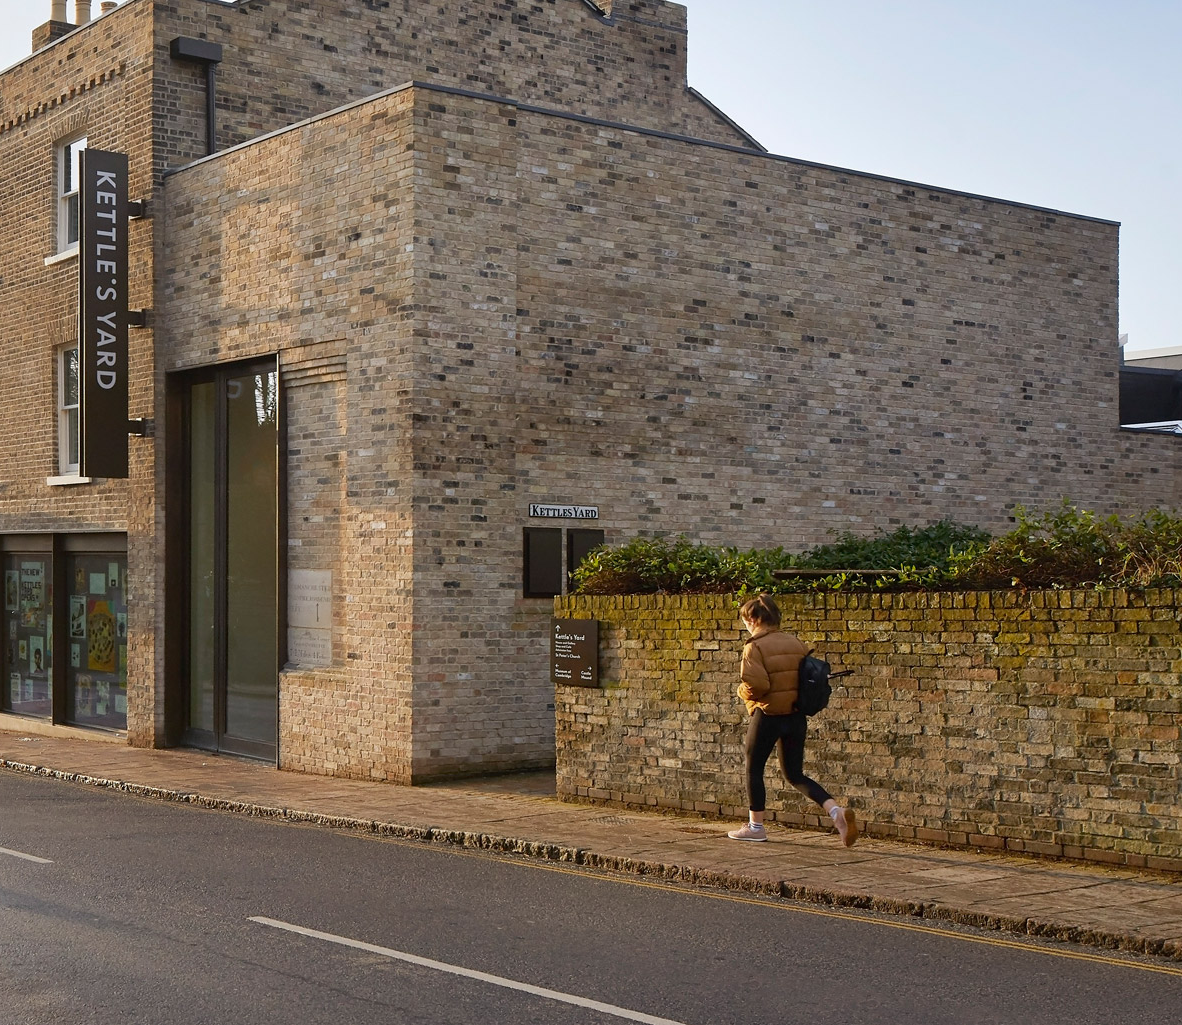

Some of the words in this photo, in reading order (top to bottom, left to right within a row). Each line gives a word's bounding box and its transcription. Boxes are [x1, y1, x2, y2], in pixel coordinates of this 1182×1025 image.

[96, 170, 117, 301] KETTLE'S
[96, 311, 117, 390] YARD
[573, 507, 596, 518] YARD
